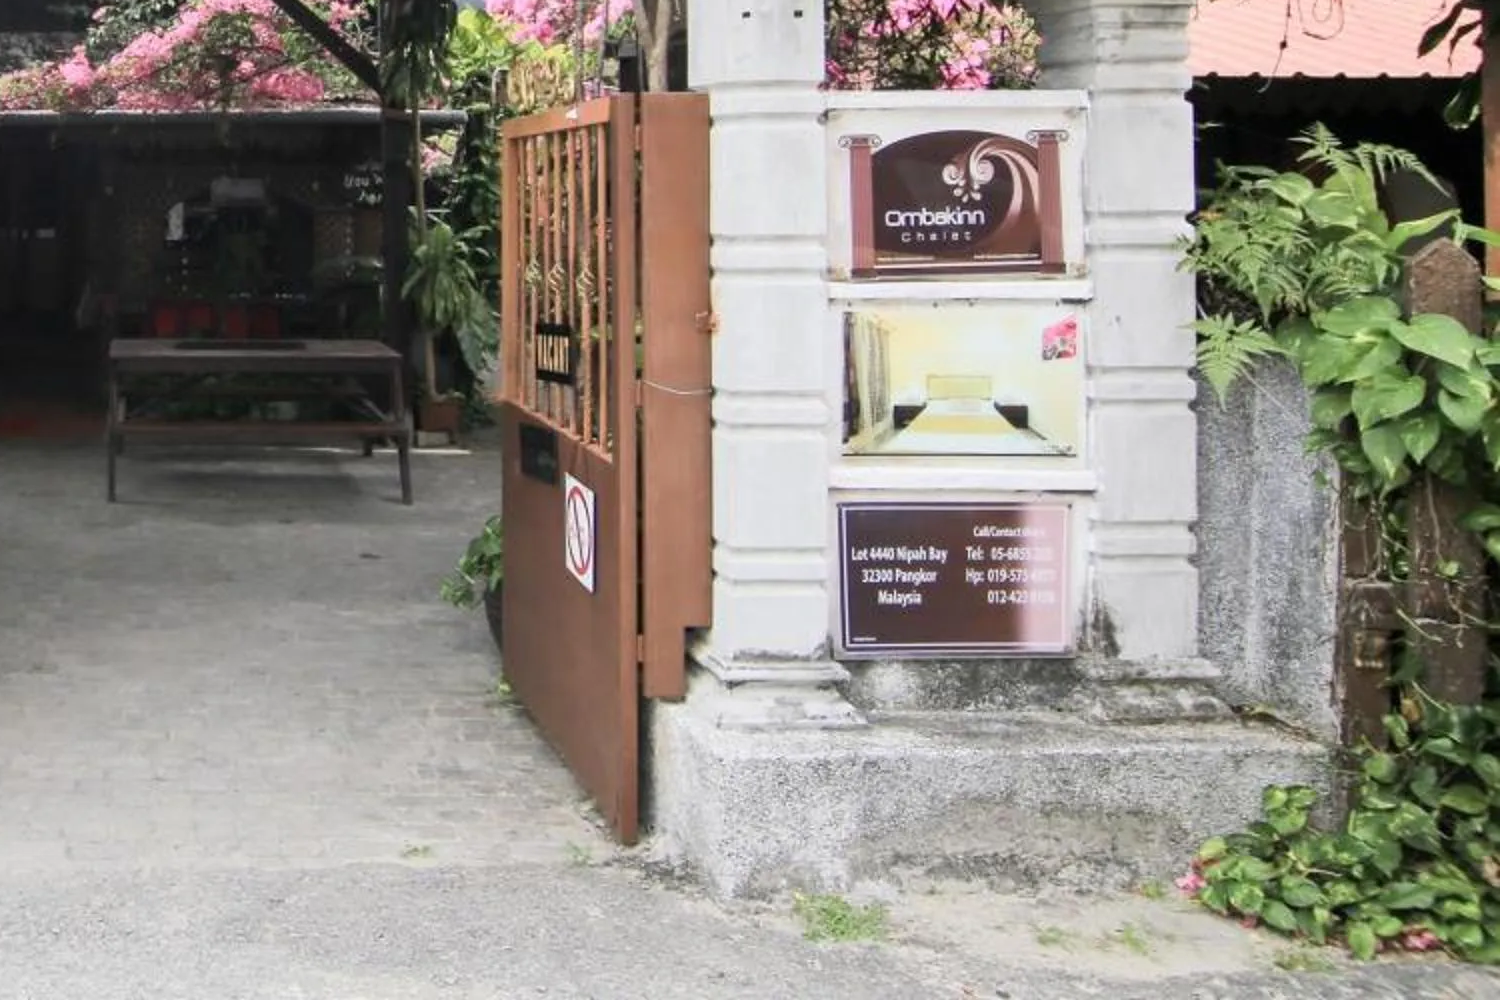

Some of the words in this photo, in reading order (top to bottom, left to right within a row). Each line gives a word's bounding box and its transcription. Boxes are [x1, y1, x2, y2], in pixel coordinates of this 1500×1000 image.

[851, 547, 869, 561] Lot
[897, 546, 927, 565] Nipah
[929, 546, 949, 565] Bay
[861, 568, 893, 583] 32300
[895, 567, 937, 587] Pangkor
[877, 587, 922, 609] Malaysia
